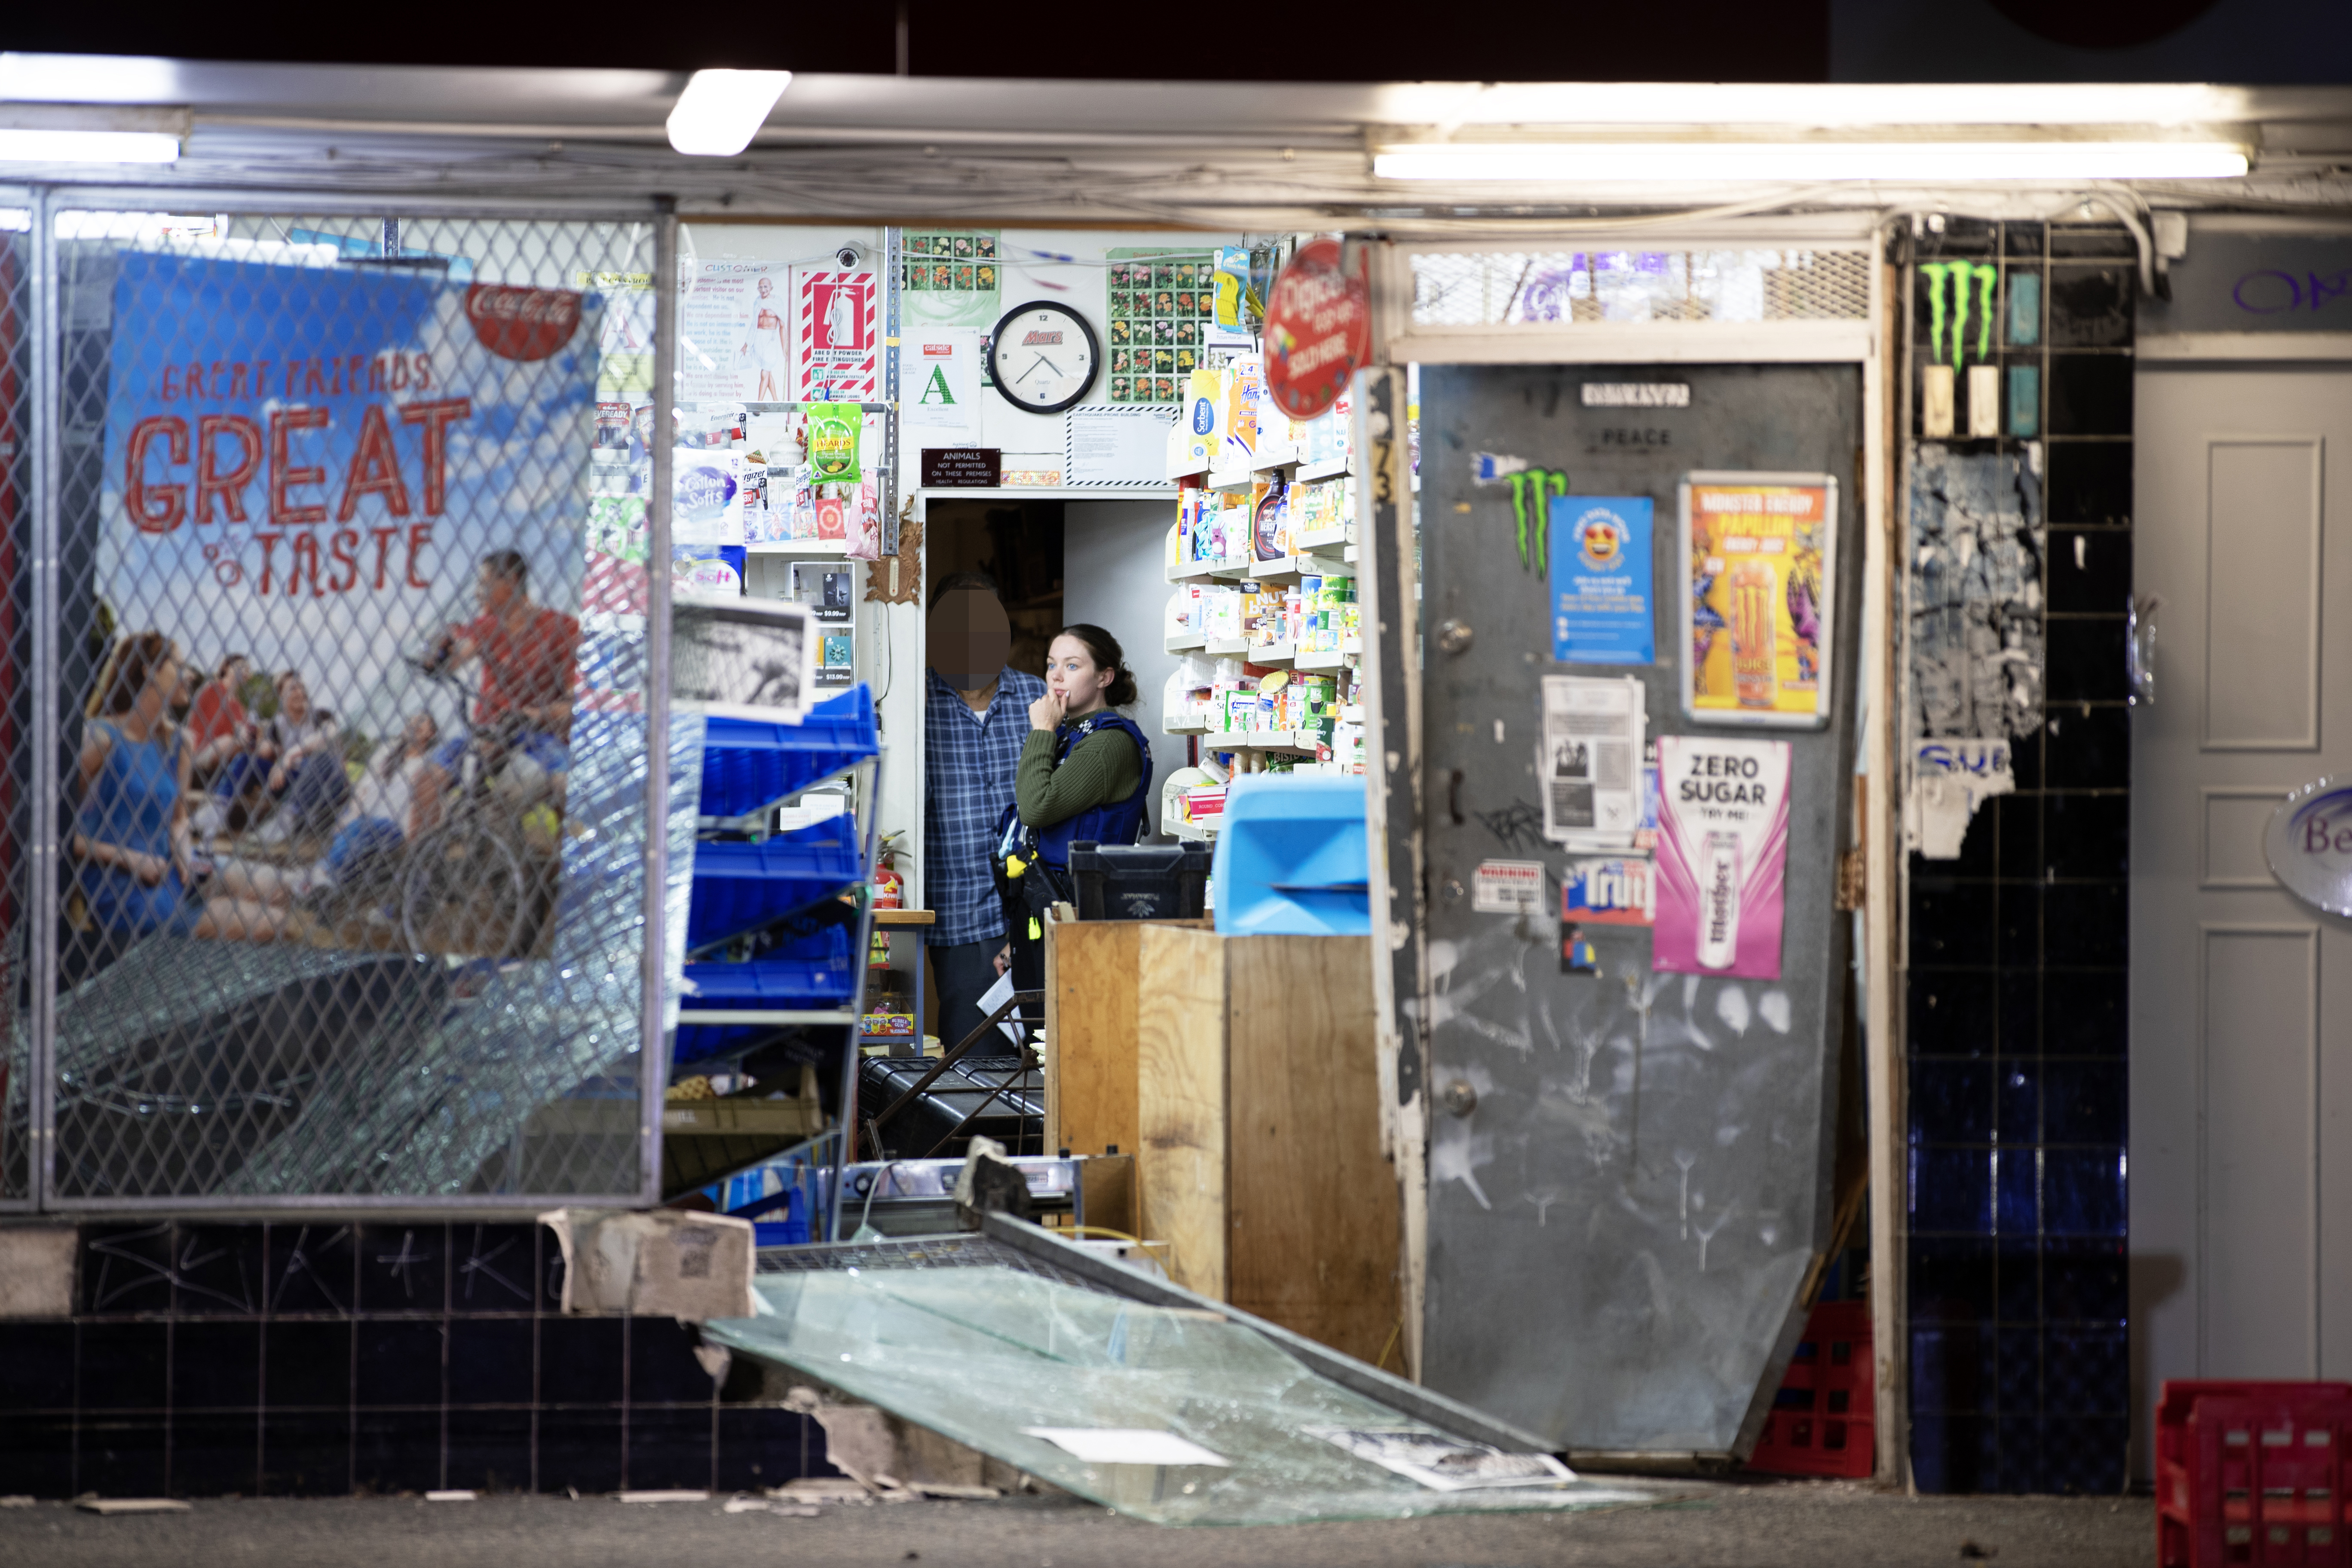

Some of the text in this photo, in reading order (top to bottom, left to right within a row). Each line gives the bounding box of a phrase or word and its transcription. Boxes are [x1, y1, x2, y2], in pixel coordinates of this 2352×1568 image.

[1023, 330, 1063, 344] Mars
[918, 363, 958, 404] A
[698, 389, 712, 398] doing
[735, 390, 742, 398] by
[594, 410, 628, 419] EVEREADY
[1197, 401, 1206, 433] Sorbent
[817, 439, 851, 447] HEARDS
[1602, 428, 1672, 446] PEACE
[943, 452, 980, 460] ANIMALS
[124, 397, 472, 534] GREAT
[685, 474, 726, 492] Cotton
[743, 470, 765, 482] rgizer
[686, 489, 724, 509] Softs
[1701, 493, 1815, 514] MONSTER ENERGY
[1719, 512, 1794, 536] PAPILLON
[254, 522, 434, 598] TASTE
[695, 570, 731, 584] Soft
[1256, 590, 1288, 606] NUT
[1274, 752, 1300, 763] BISTO
[1690, 753, 1760, 779] ZERO
[1679, 779, 1767, 805] SUGAR
[1700, 806, 1749, 821] TRY ME!
[2302, 815, 2352, 854] Be
[1479, 867, 1538, 878] WARNING
